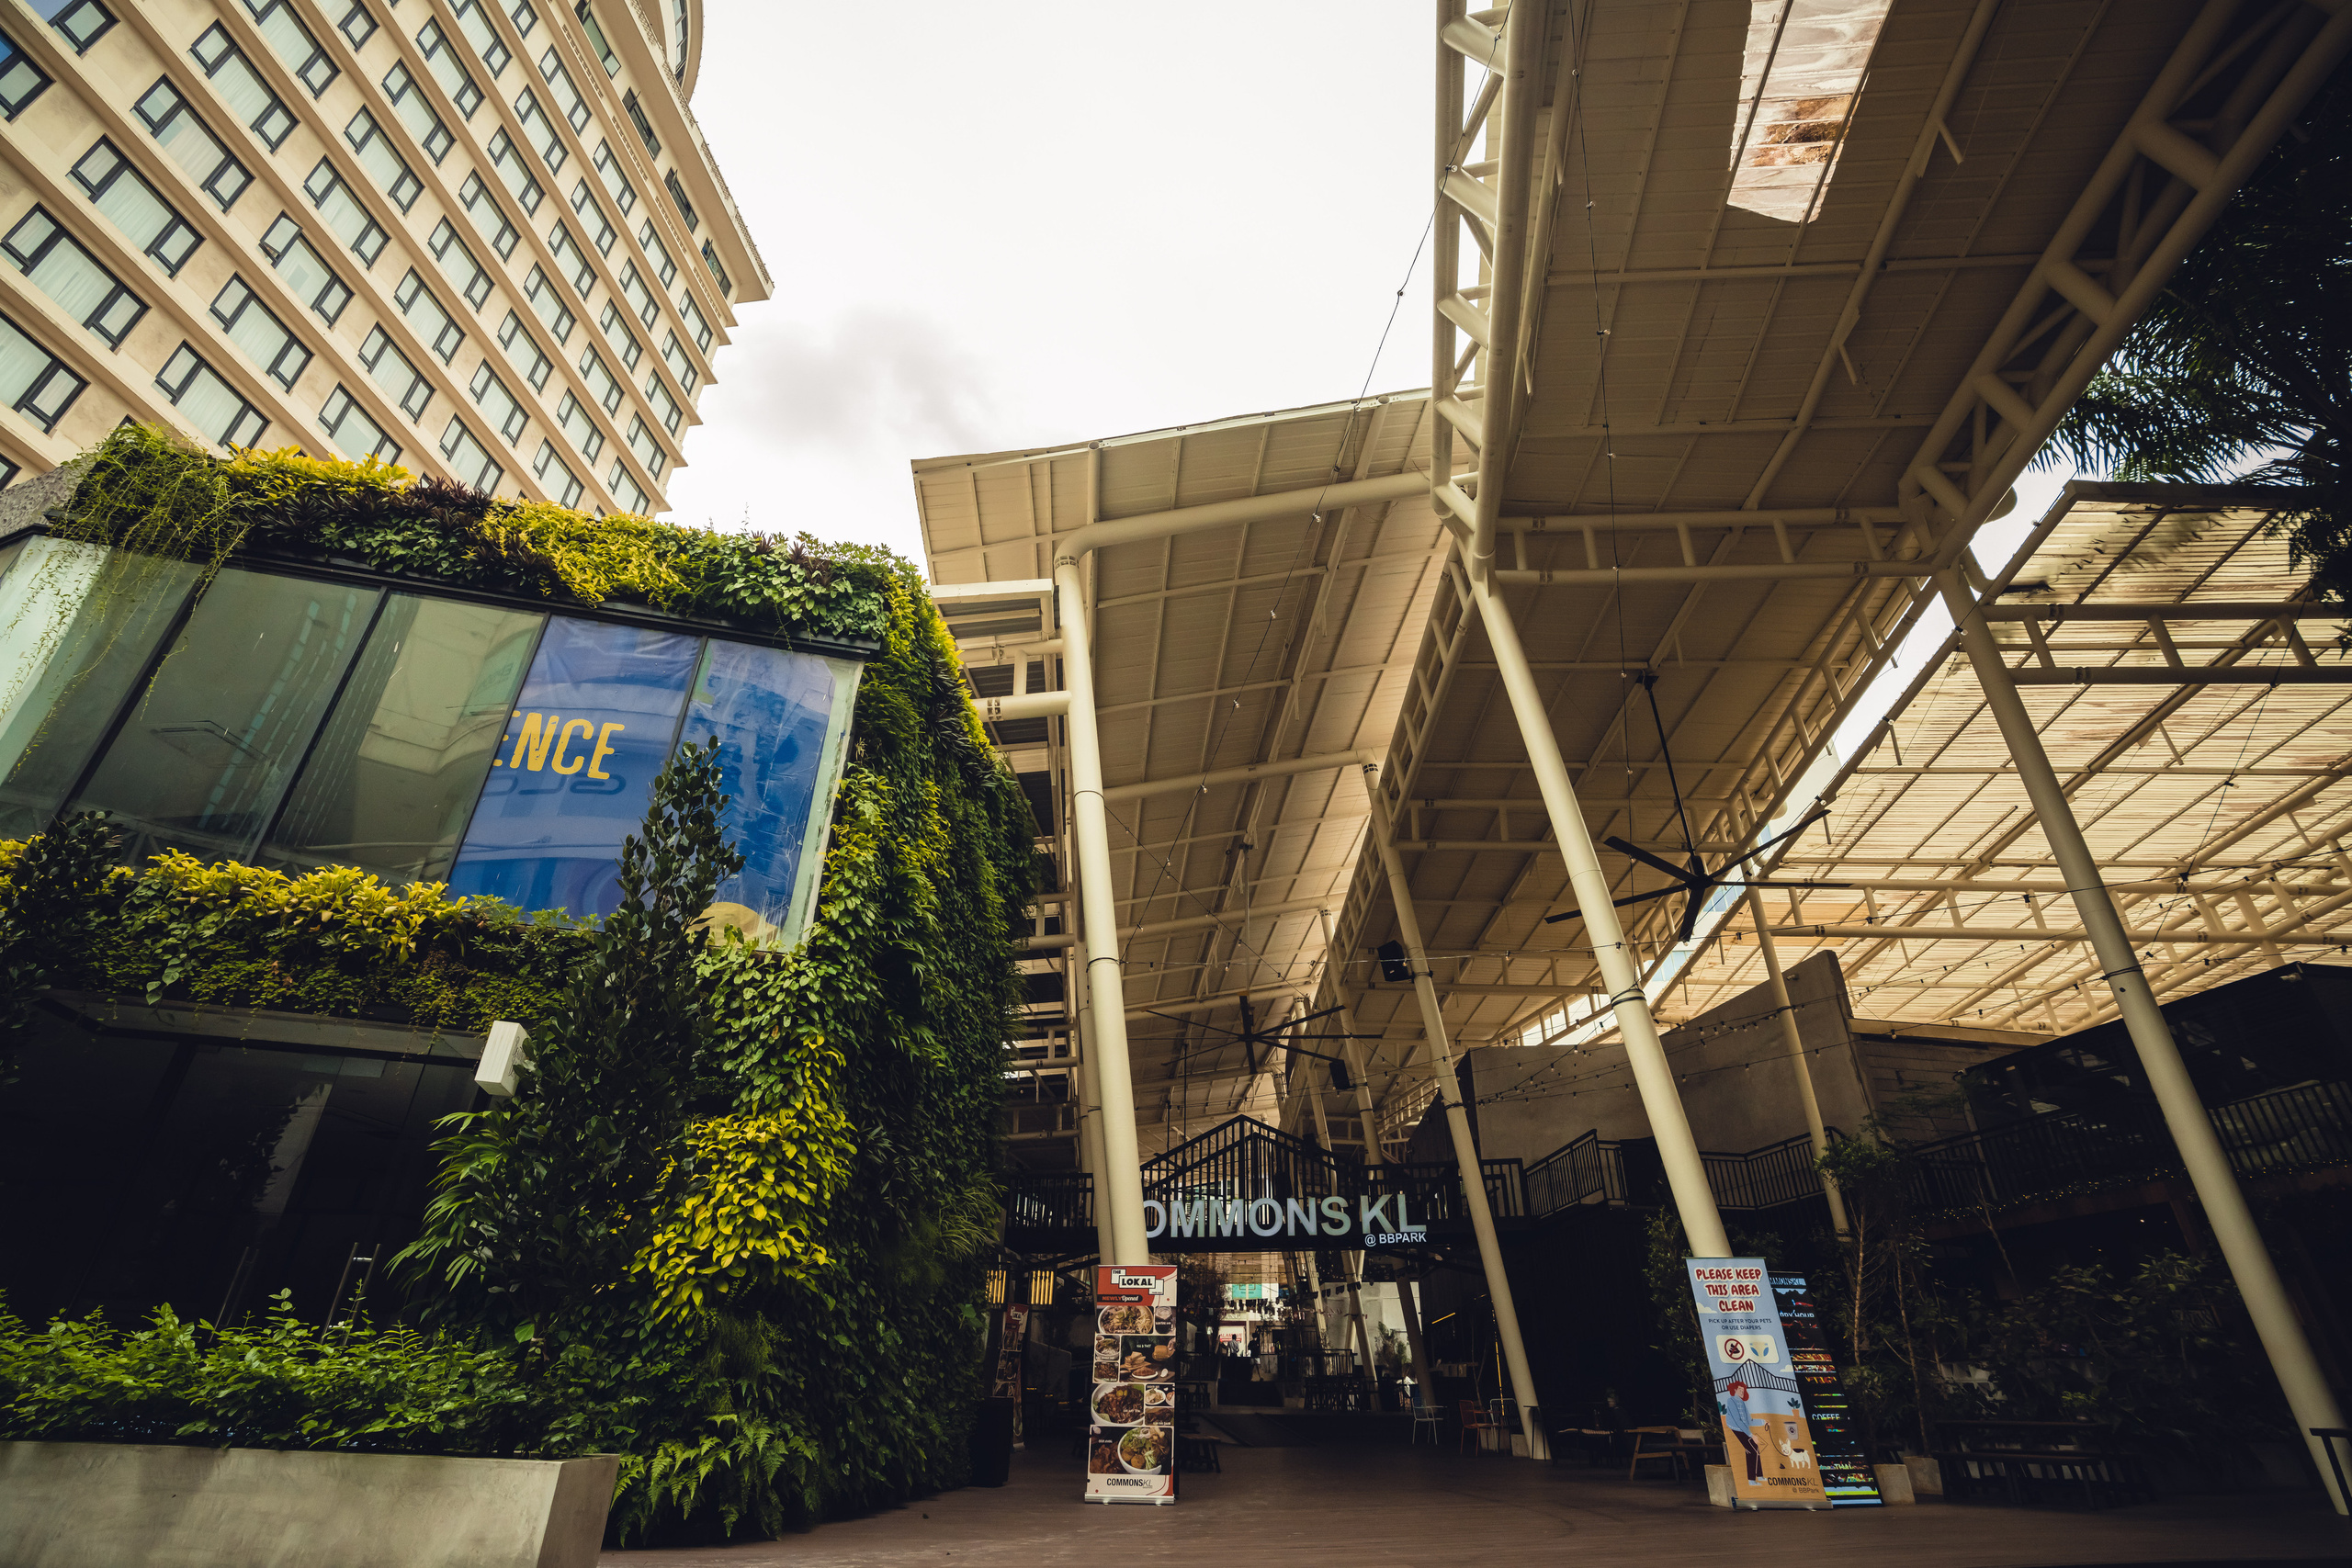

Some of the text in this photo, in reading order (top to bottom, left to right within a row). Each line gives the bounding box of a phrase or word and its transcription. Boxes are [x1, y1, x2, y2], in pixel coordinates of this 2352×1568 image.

[1142, 1193, 1427, 1237] OMMONS KL
[1364, 1232, 1427, 1247] @ BBPARK
[1695, 1268, 1761, 1280] PLEASE KEEP
[1122, 1278, 1152, 1286] LOKAL
[1704, 1284, 1759, 1296] THIS AREA
[1718, 1300, 1754, 1312] CLEAN
